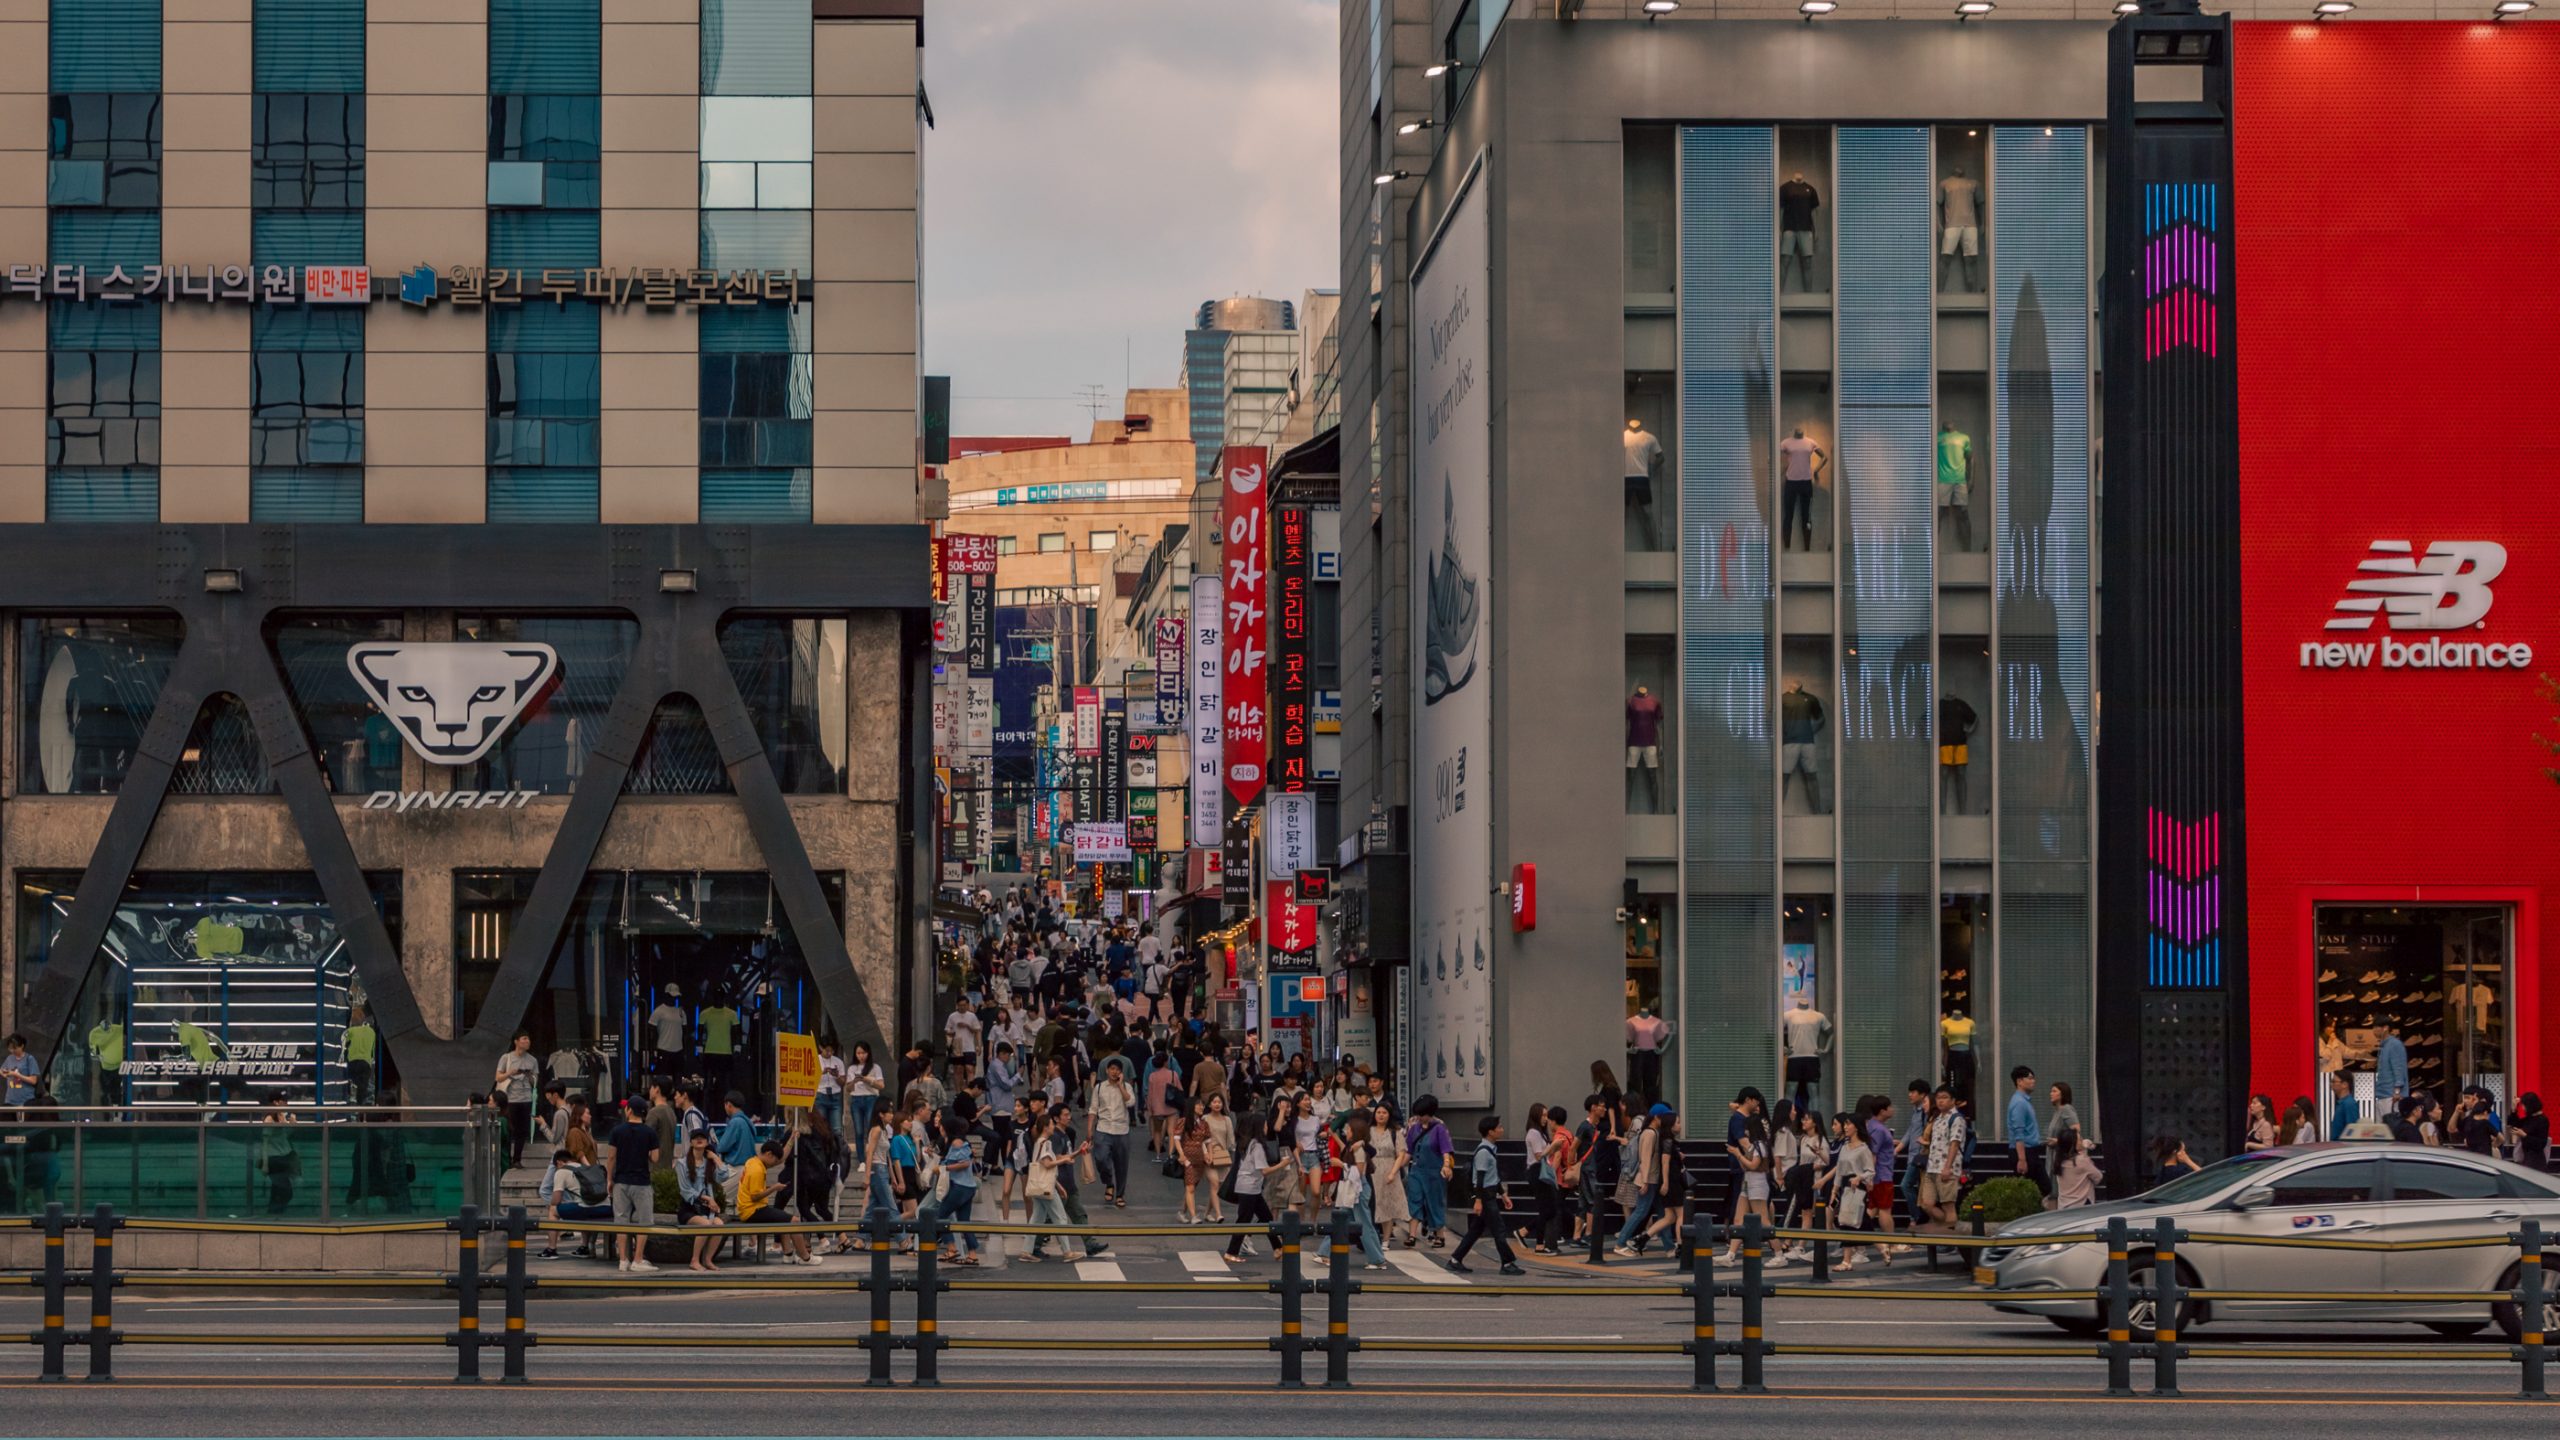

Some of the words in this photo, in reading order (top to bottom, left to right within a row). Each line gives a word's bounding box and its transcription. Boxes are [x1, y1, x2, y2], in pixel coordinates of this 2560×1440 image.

[9, 265, 86, 302] 닥터
[101, 264, 297, 302] 스키니의원
[1427, 403, 1439, 445] but
[954, 537, 997, 559] 부동산
[1228, 507, 1266, 677] 이자카야
[970, 589, 987, 670] 강남고시원
[2300, 642, 2376, 668] new
[2381, 636, 2533, 669] balance
[1200, 628, 1219, 777] 장인닭갈비
[1227, 701, 1264, 726] 미소
[1108, 729, 1118, 768] CRAFT
[1227, 726, 1264, 743] 다이닝
[362, 790, 540, 813] DYNAFIT
[1287, 801, 1302, 870] 장인닭갈비
[2319, 935, 2347, 944] FAST
[1274, 1030, 1301, 1039] 강남주
[229, 1044, 269, 1060] 뜨거운
